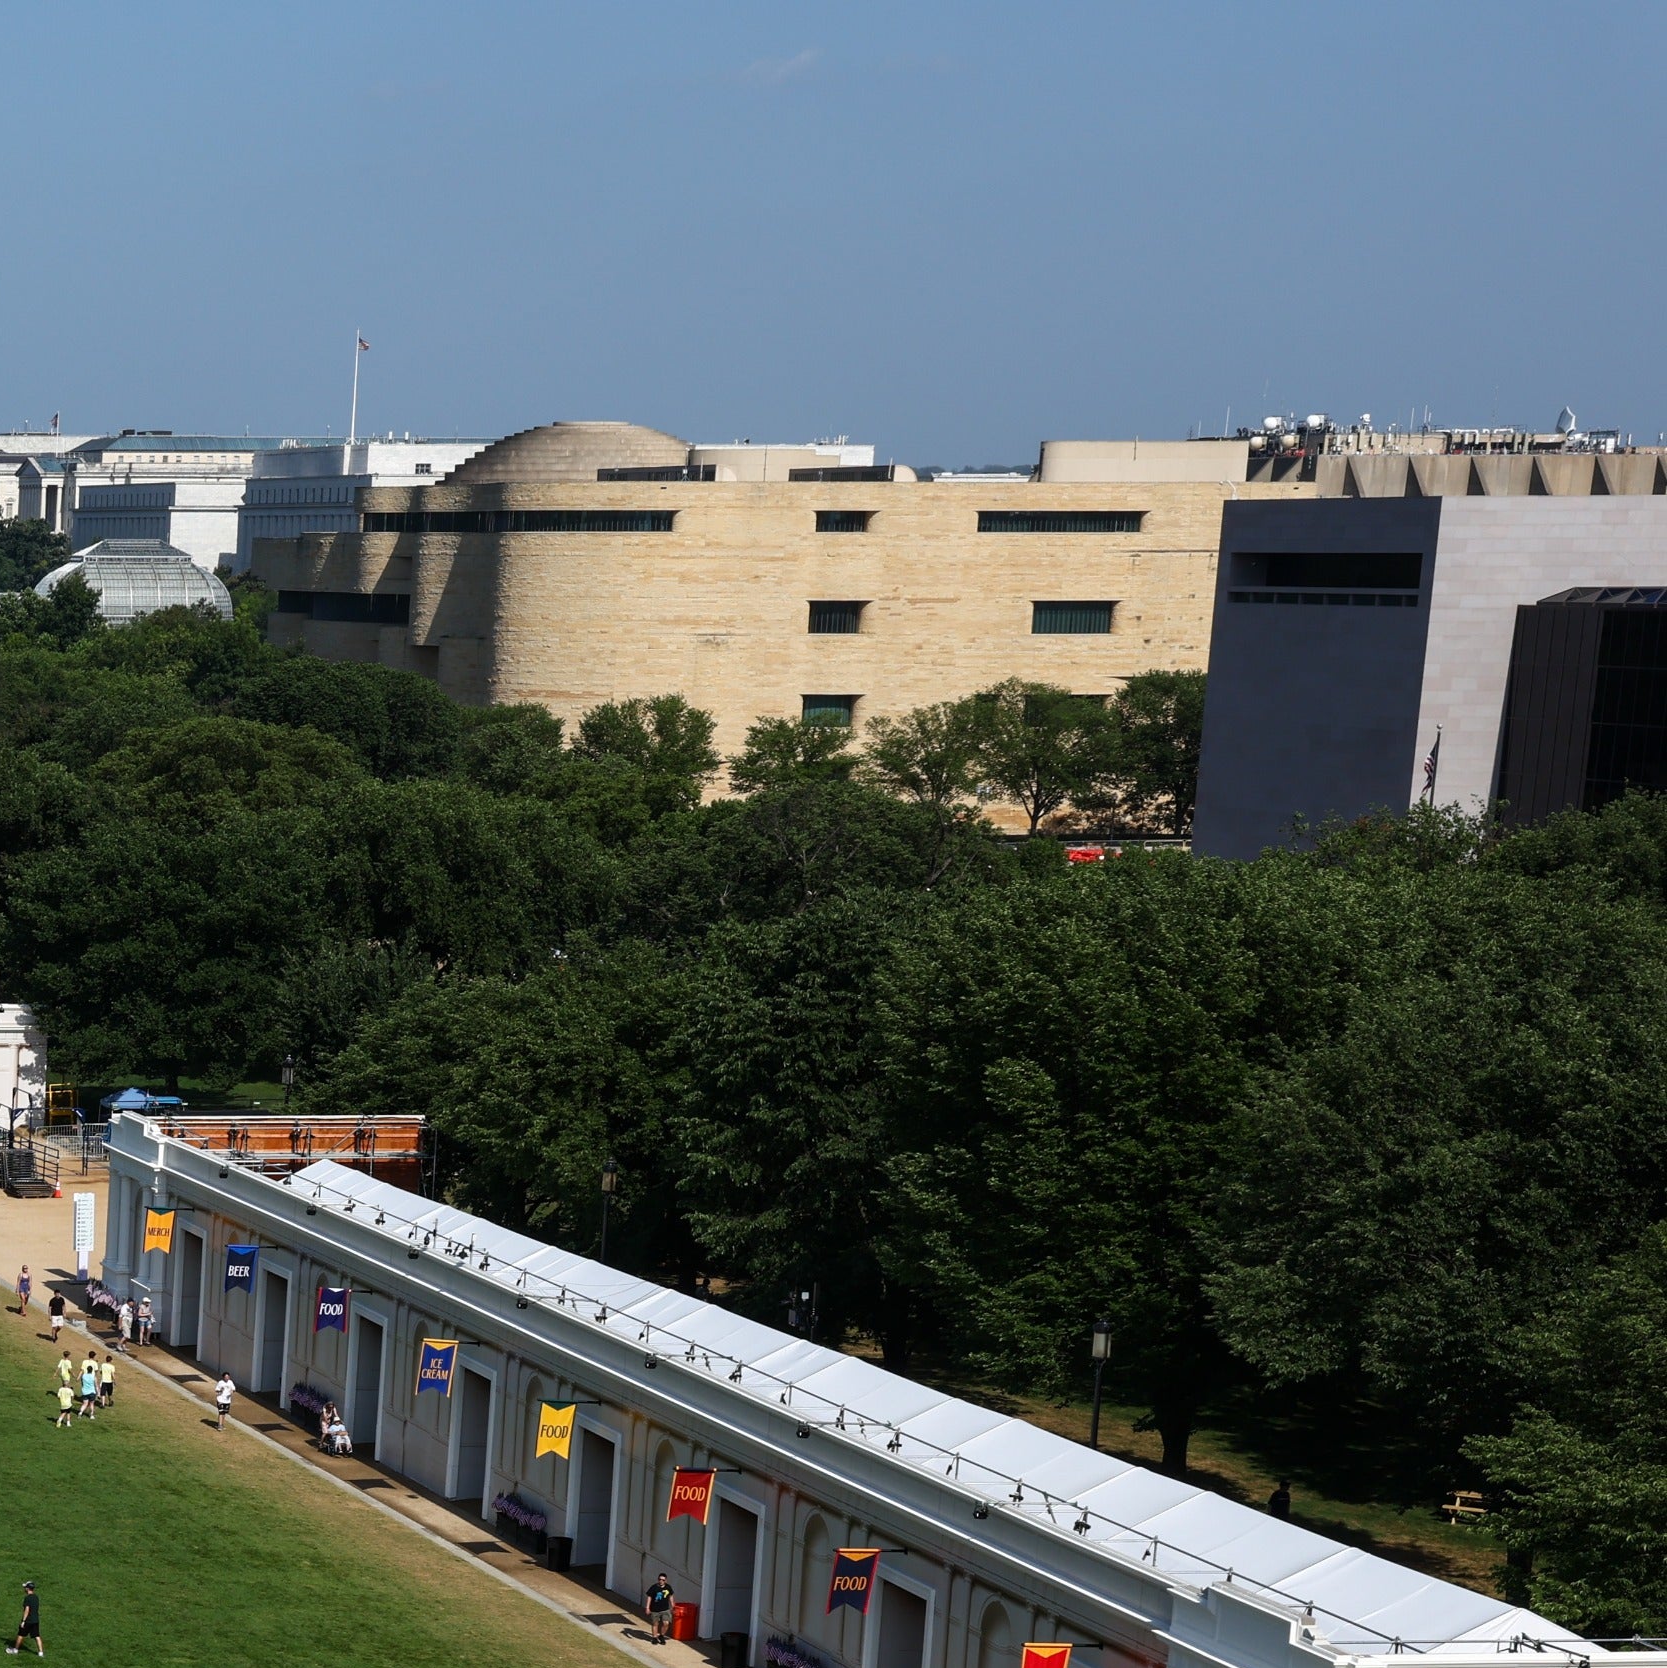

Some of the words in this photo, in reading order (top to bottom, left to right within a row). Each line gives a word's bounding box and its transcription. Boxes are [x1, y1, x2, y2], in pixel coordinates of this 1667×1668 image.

[147, 1226, 170, 1237] MERCH
[228, 1265, 250, 1277] BEER
[319, 1302, 344, 1316] FOOD
[431, 1358, 444, 1369] ICE
[421, 1368, 448, 1380] CREAM
[540, 1425, 568, 1438] FOOD
[675, 1485, 706, 1501] FOOD
[833, 1576, 867, 1591] FOOD
